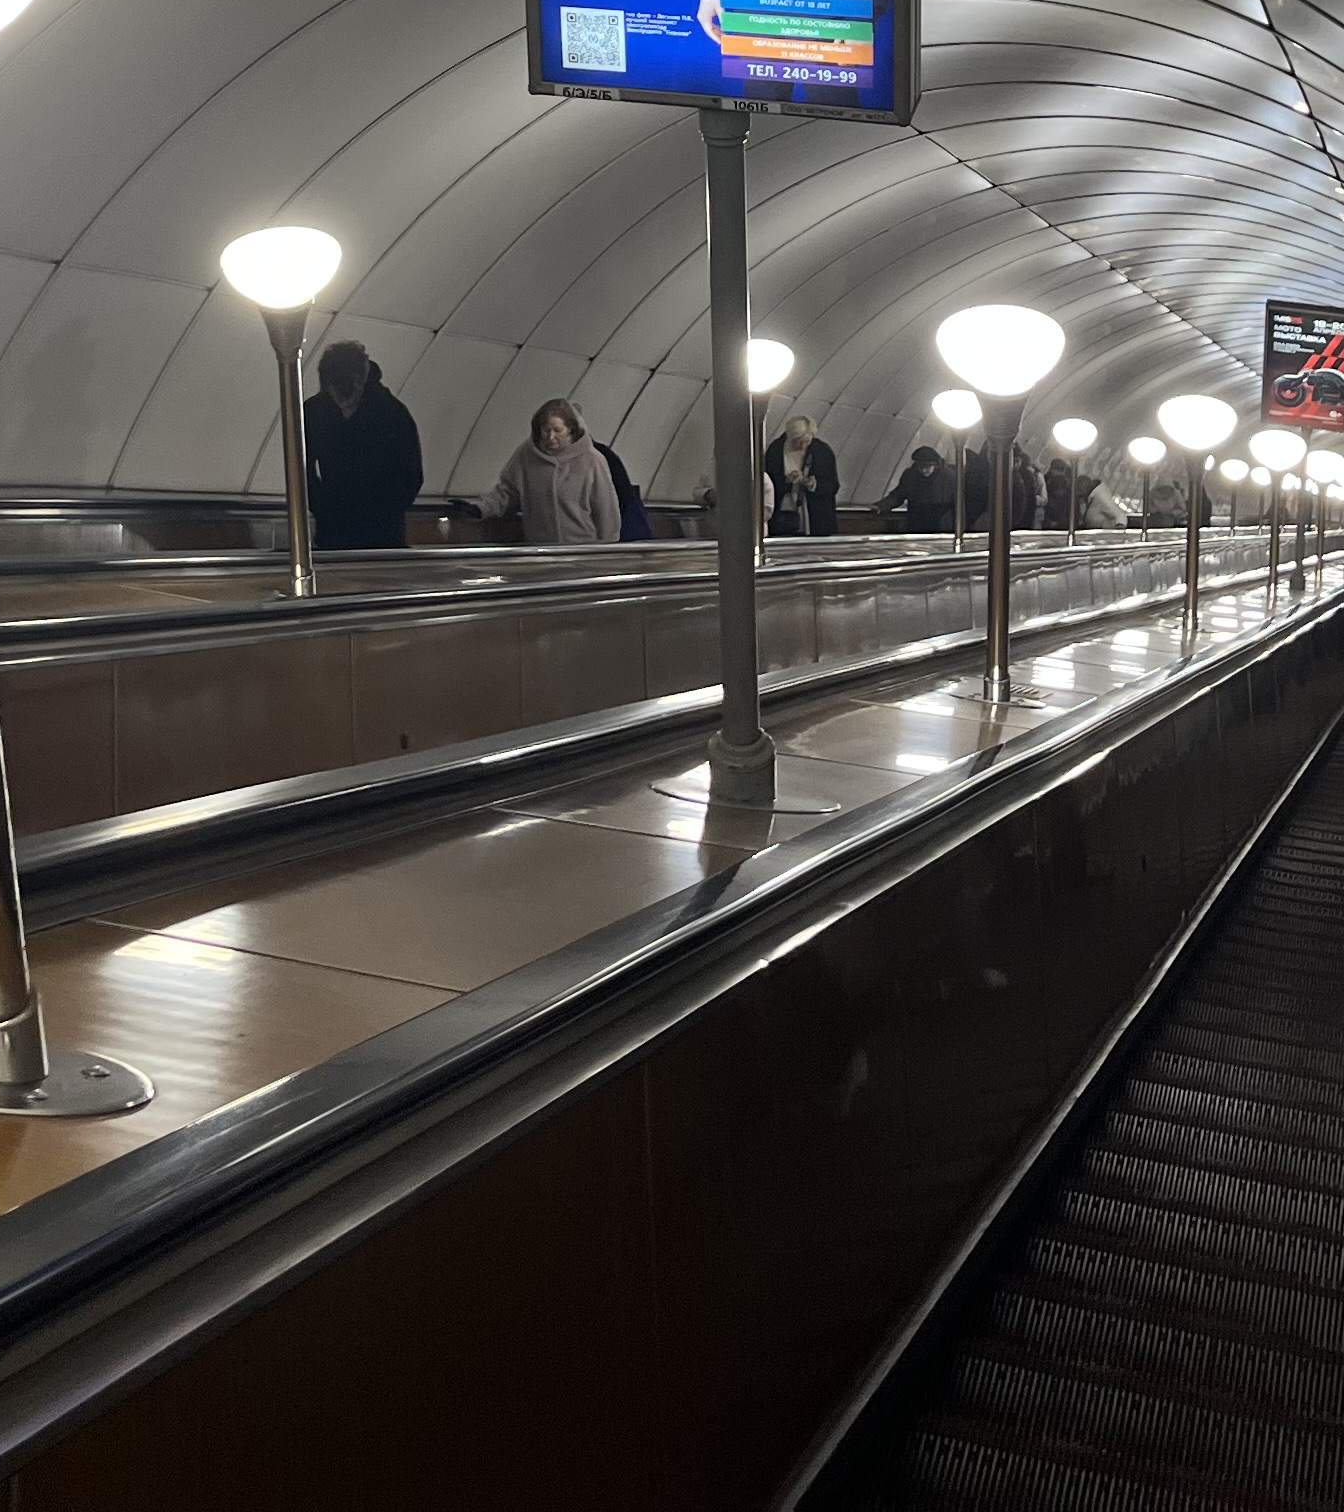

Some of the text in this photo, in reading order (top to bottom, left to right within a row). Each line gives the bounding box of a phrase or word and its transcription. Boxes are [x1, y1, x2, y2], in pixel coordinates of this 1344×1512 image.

[794, 0, 805, 8] ОТ
[817, 2, 831, 10] ЛЕТ
[748, 15, 788, 25] ГОДНОСТЬ
[790, 18, 801, 26] ПО
[747, 64, 857, 84] ТЕЛ. 240-19-99
[1273, 324, 1302, 333] МОТО
[1273, 331, 1327, 344] ВЫСТАВКА
